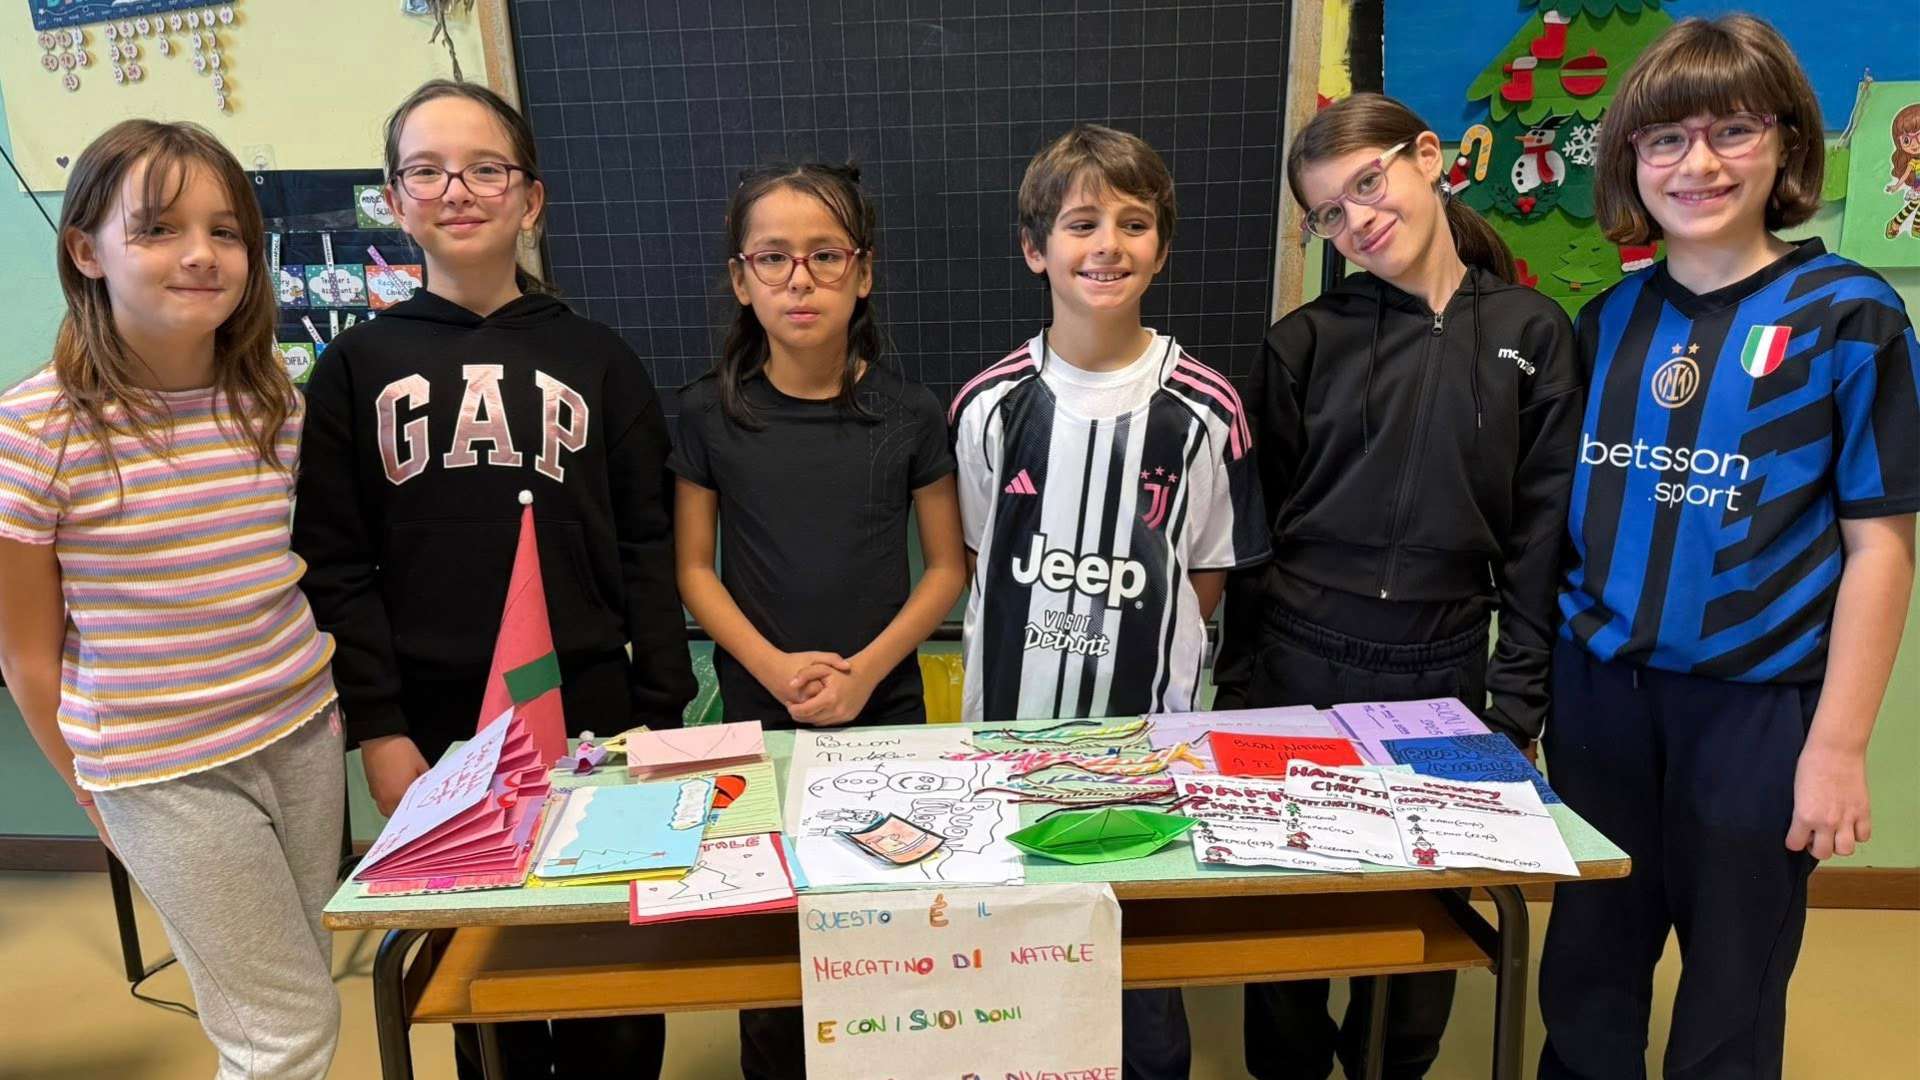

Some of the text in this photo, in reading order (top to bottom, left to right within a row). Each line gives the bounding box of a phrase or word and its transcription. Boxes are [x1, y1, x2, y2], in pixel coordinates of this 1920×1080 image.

[375, 364, 589, 486] GAP
[1580, 433, 1750, 480] betsson
[1011, 532, 1148, 609] Jeep
[1024, 623, 1110, 656] Detroit
[1044, 610, 1092, 633] VISIT
[702, 835, 760, 852] TALE
[806, 909, 892, 931] QUESTO
[978, 902, 992, 918] IL
[813, 944, 1095, 982] MERCATINO DI NATALE
[817, 1021, 838, 1043] E
[846, 1016, 886, 1036] CON
[909, 1009, 963, 1030] SUOI
[974, 1006, 1022, 1024] DONI
